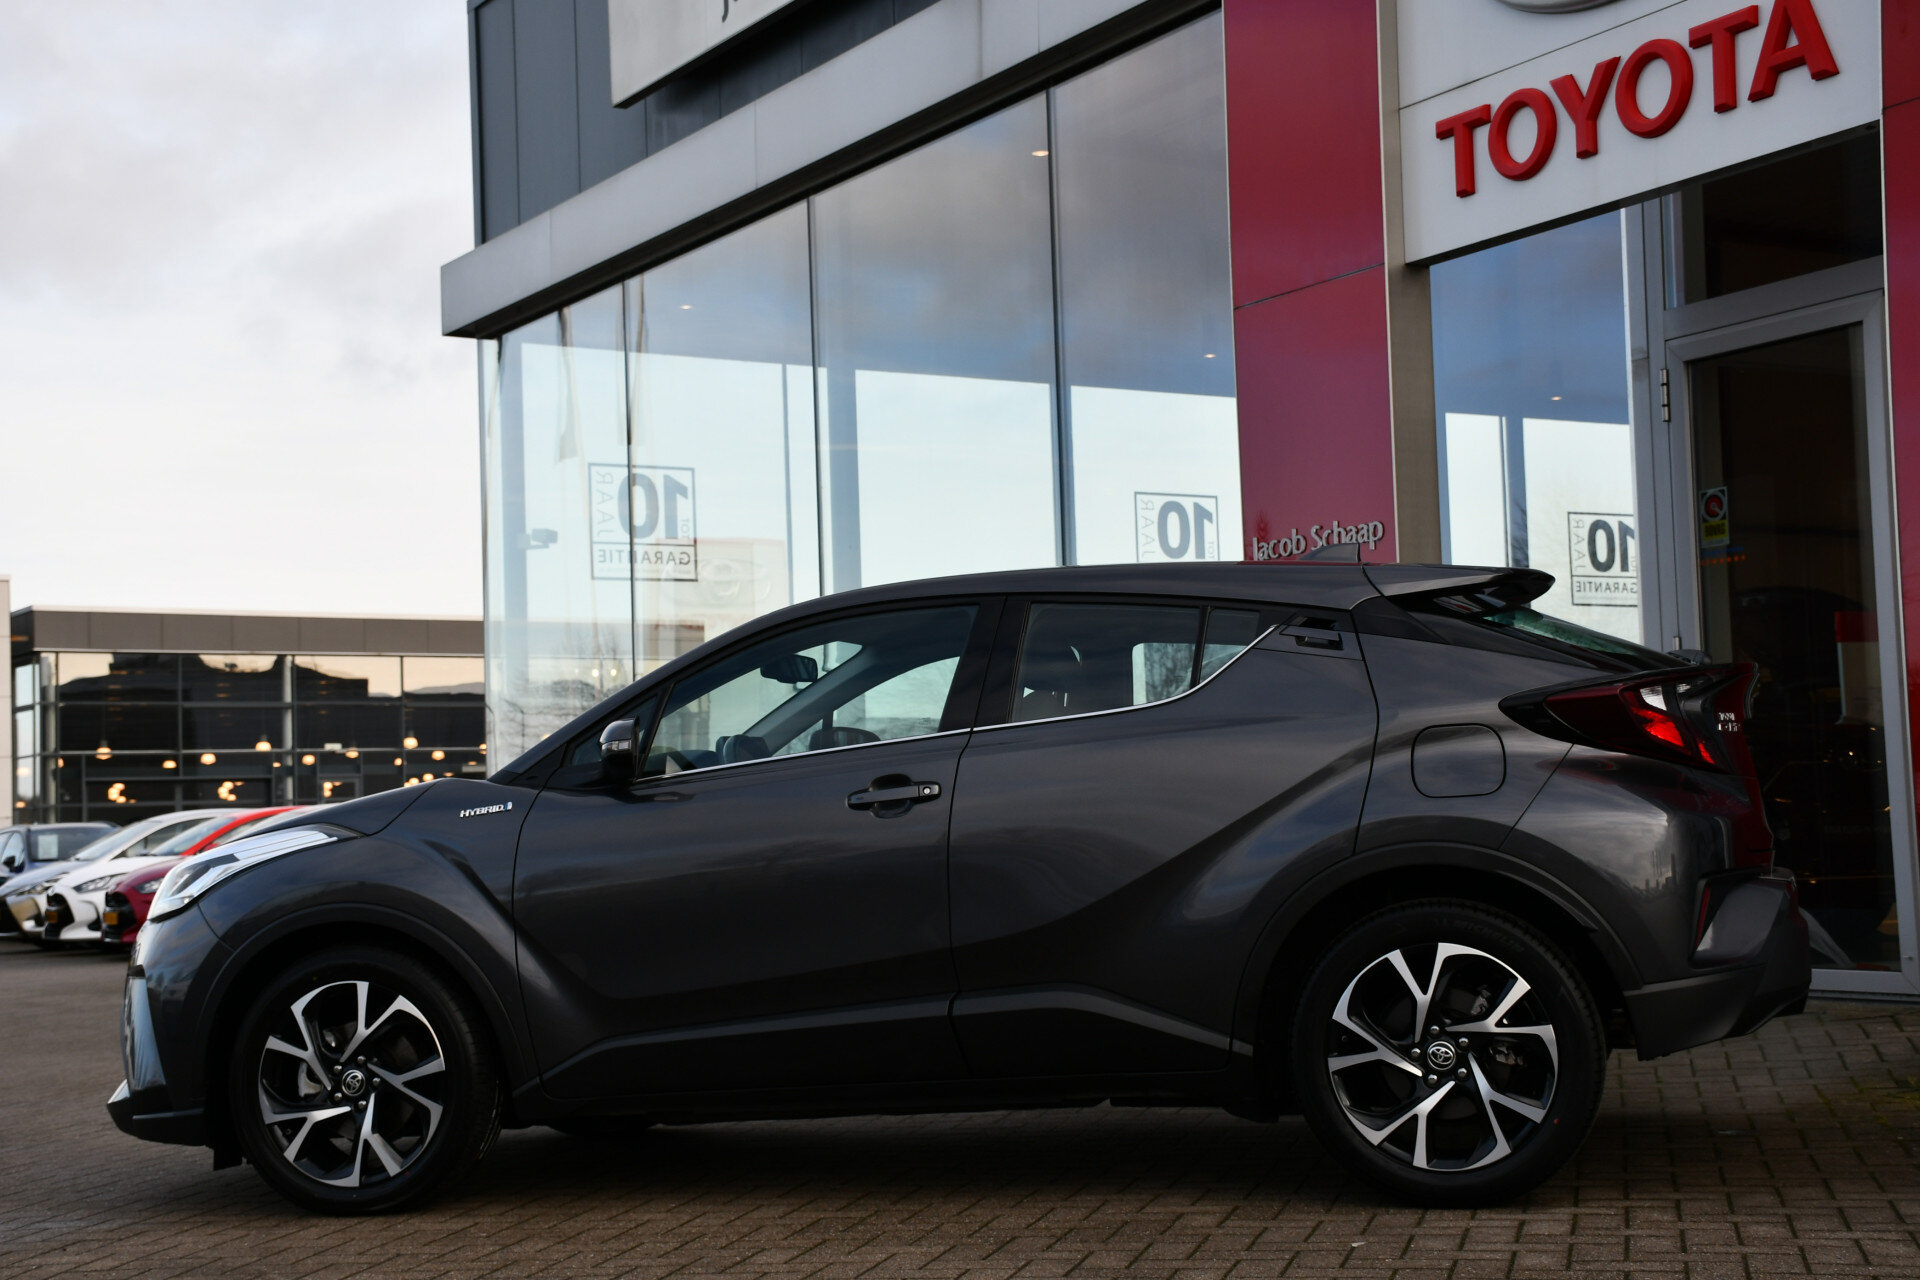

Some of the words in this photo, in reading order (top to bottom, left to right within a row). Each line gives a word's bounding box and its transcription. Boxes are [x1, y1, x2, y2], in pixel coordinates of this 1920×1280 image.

[1435, 0, 1839, 198] TOYOTA
[1310, 520, 1384, 551] Schaap
[459, 804, 505, 818] HYBRID
